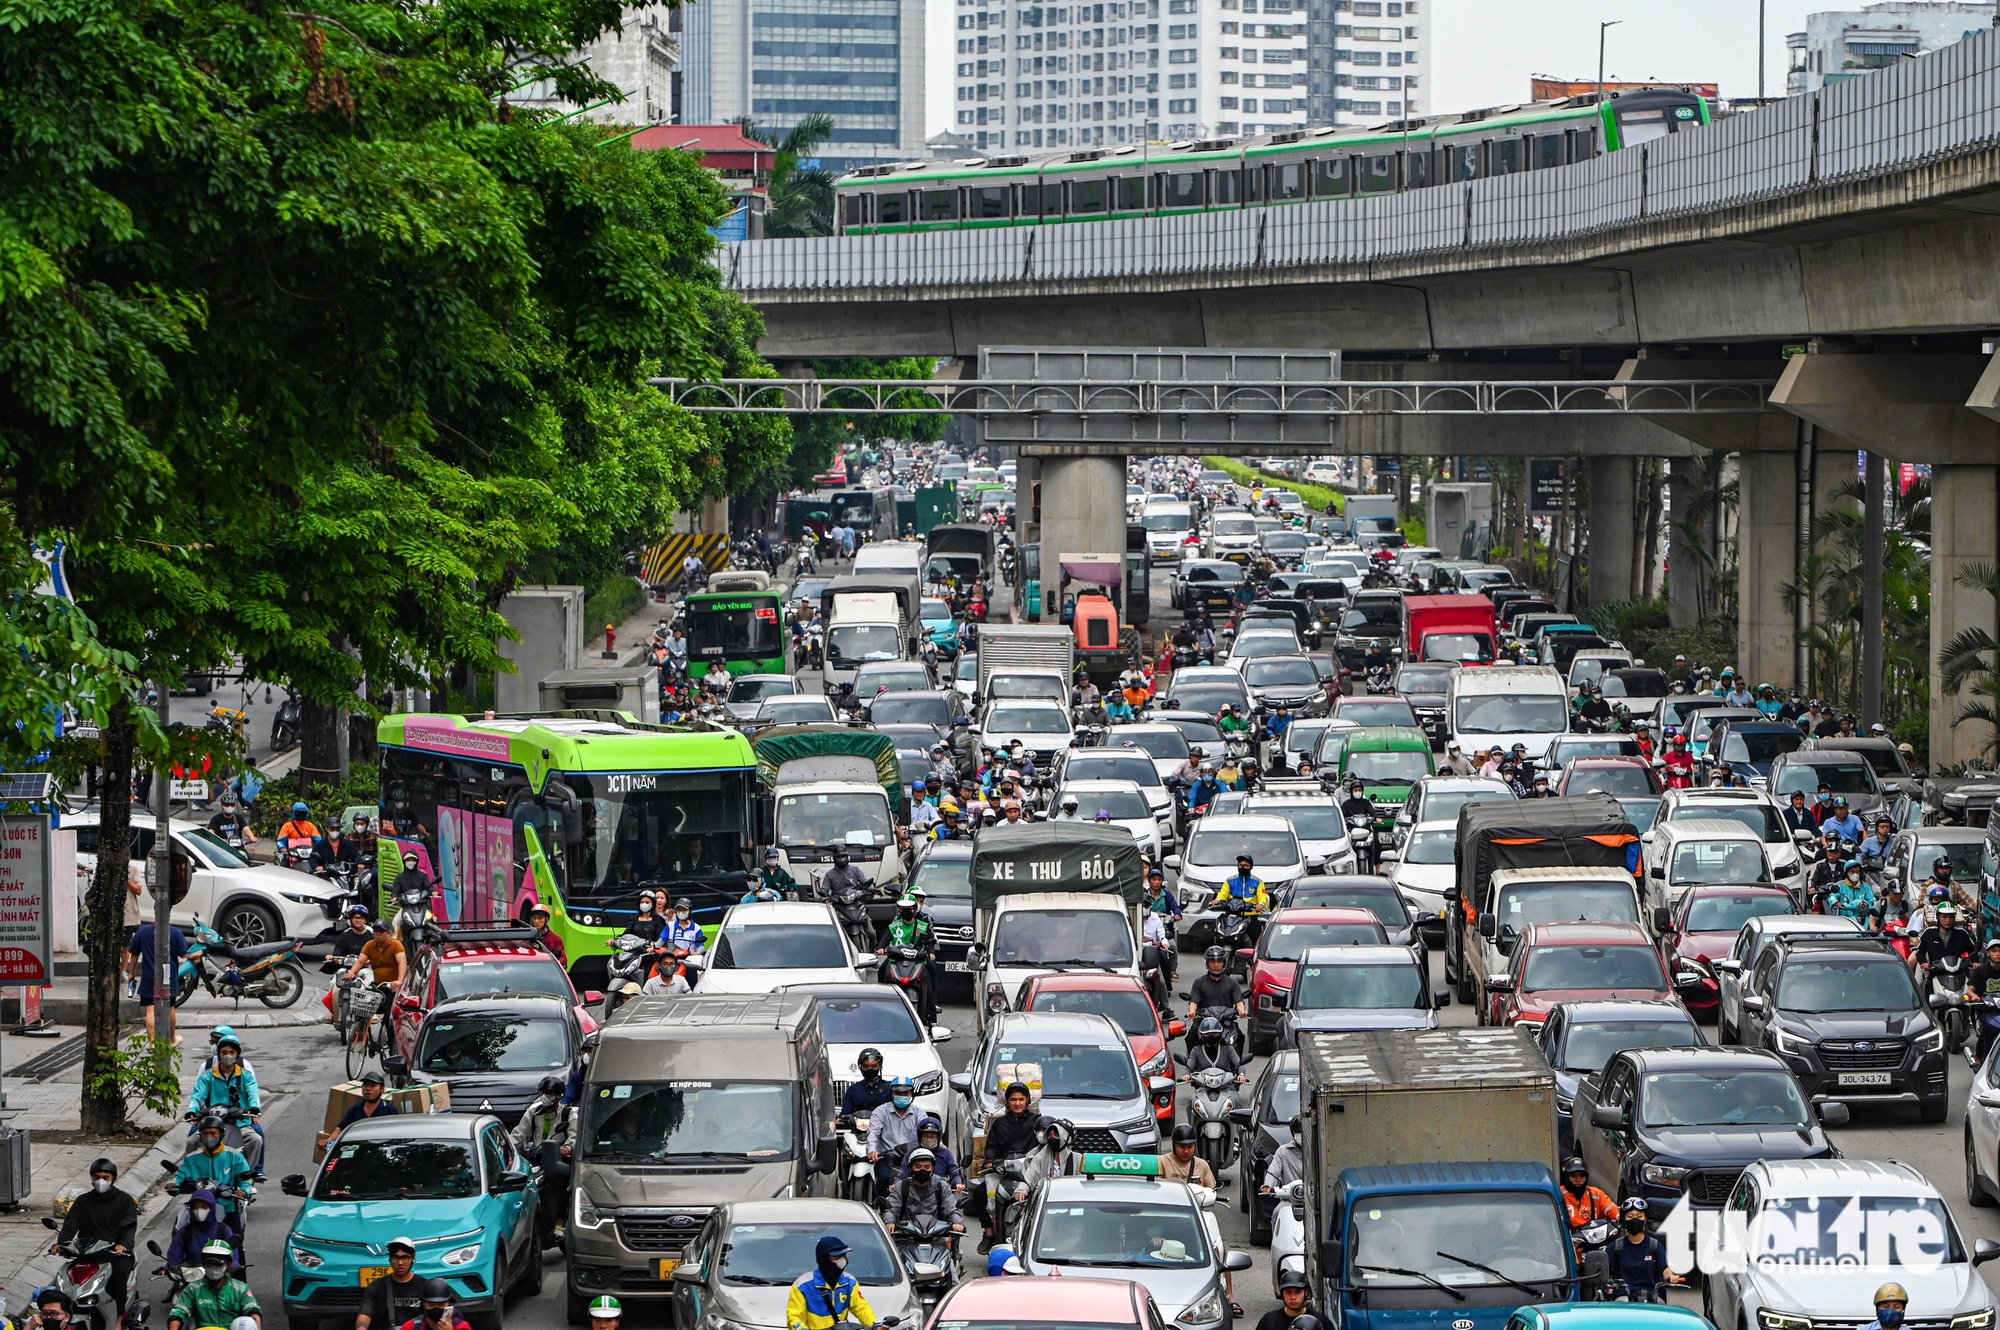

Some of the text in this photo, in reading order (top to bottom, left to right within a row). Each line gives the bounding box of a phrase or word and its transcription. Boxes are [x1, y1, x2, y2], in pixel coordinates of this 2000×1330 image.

[1676, 108, 1693, 117] 002
[633, 774, 656, 790] NĂM
[27, 825, 38, 840] TẾ
[4, 847, 21, 859] SƠN
[992, 854, 1115, 880] XE THƯ BÁO
[1, 894, 41, 906] TỐT NHẤT
[0, 910, 17, 921] ÍNH
[5, 950, 23, 961] 899
[13, 963, 23, 973] HÀ
[24, 963, 37, 975] NỘI
[1101, 1156, 1142, 1170] Grab
[672, 1217, 689, 1225] Ford
